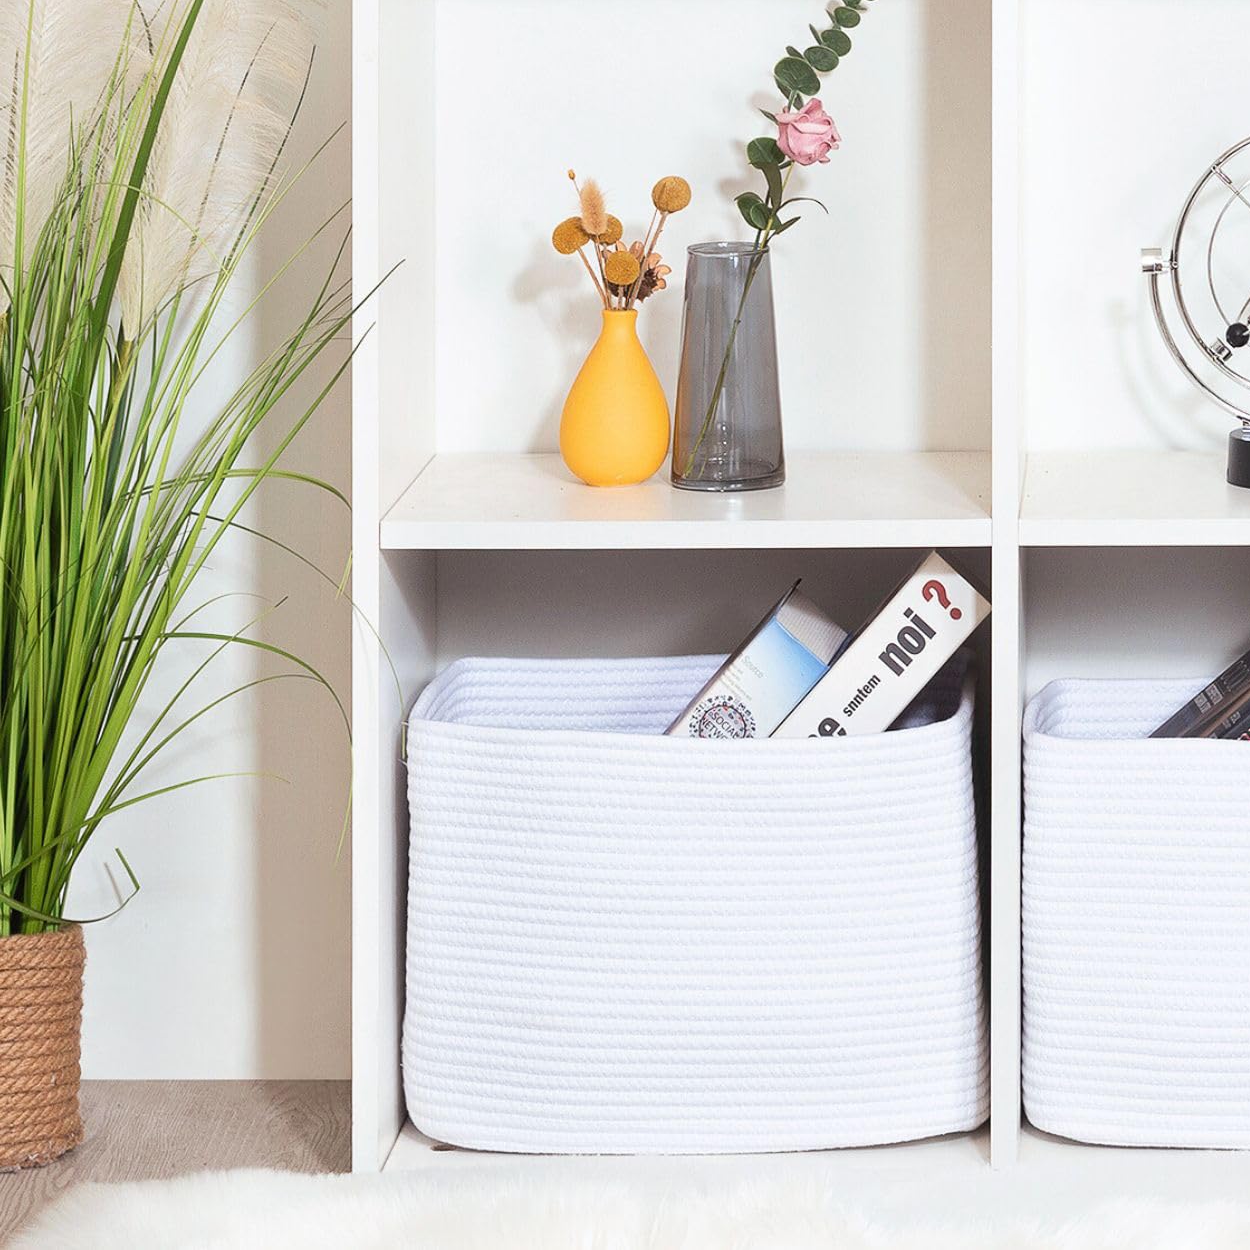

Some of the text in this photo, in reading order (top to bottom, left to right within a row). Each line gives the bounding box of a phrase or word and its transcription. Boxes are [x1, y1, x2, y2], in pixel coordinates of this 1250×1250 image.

[842, 674, 881, 717] snntem
[879, 607, 937, 677] noi
[922, 580, 962, 620] ?
[711, 712, 740, 738] SOCIAL
